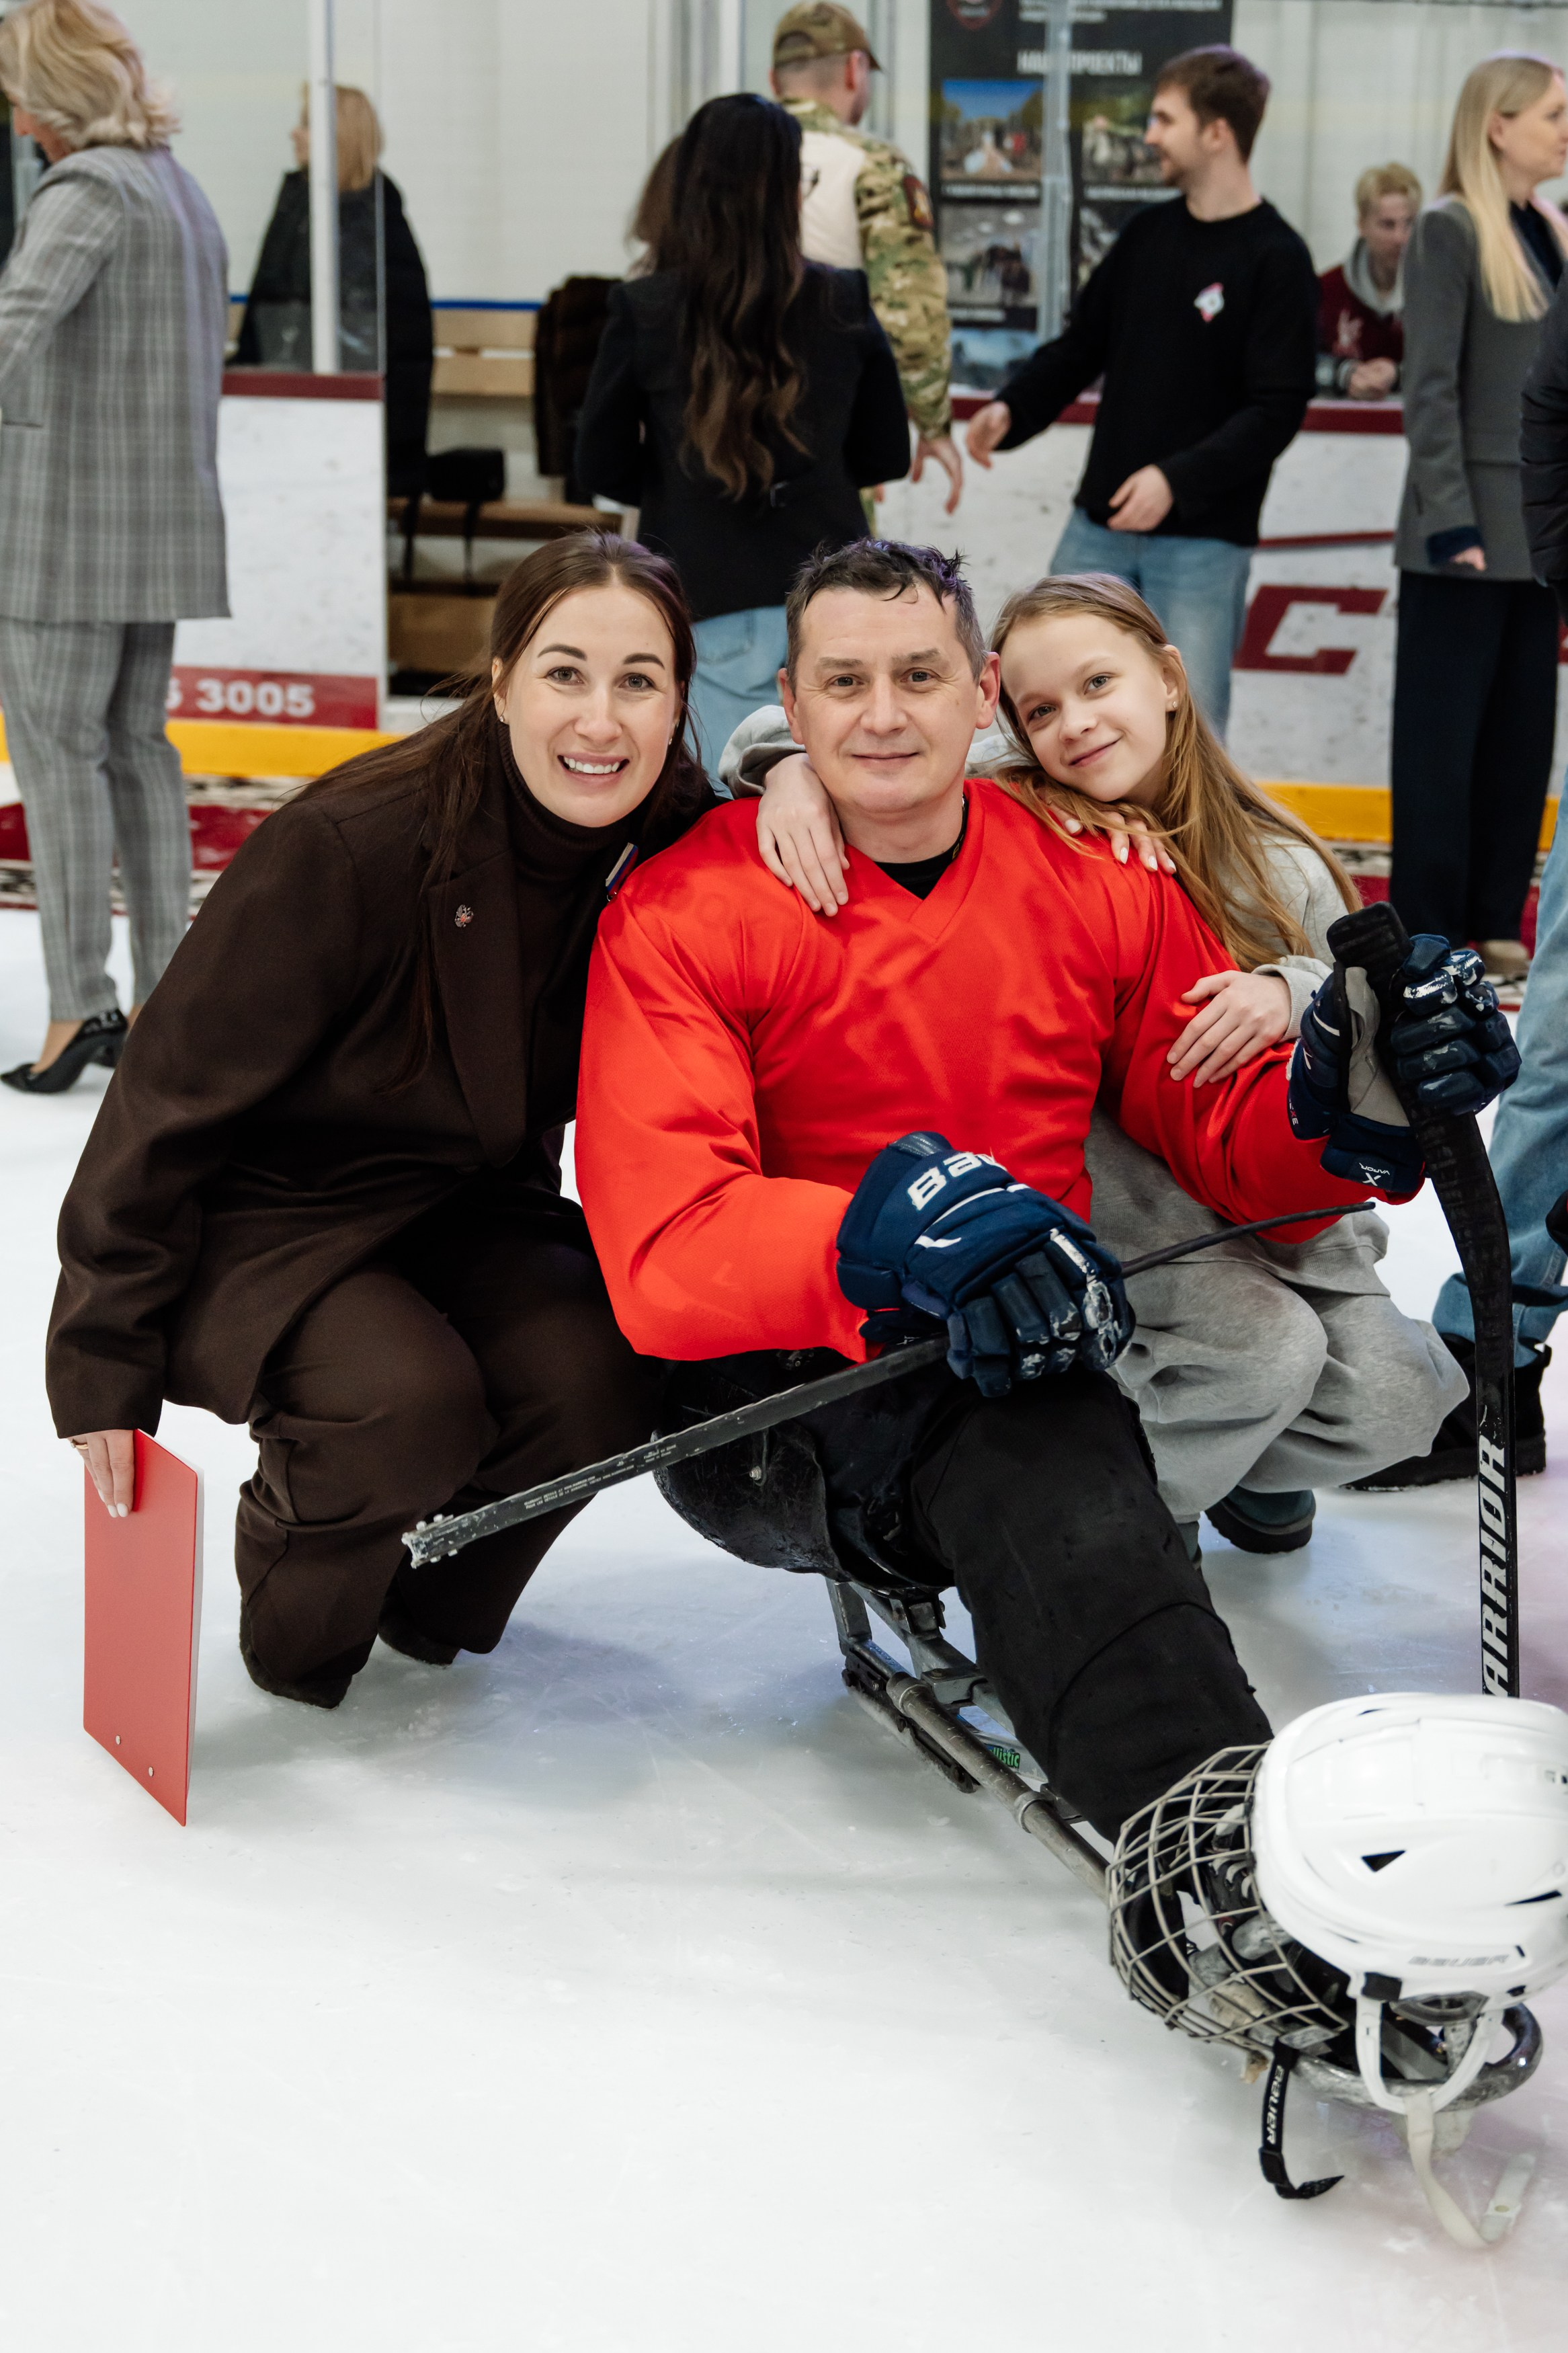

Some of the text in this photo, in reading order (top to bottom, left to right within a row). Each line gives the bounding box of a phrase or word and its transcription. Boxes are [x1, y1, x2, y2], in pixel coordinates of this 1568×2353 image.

[196, 677, 316, 717] 3005
[1358, 1162, 1391, 1176] VAPOR
[1479, 1434, 1508, 1698] ARRIOR
[990, 1746, 1020, 1768] llistic
[1408, 1954, 1510, 1966] BAUER
[1266, 2065, 1285, 2145] BAUER
